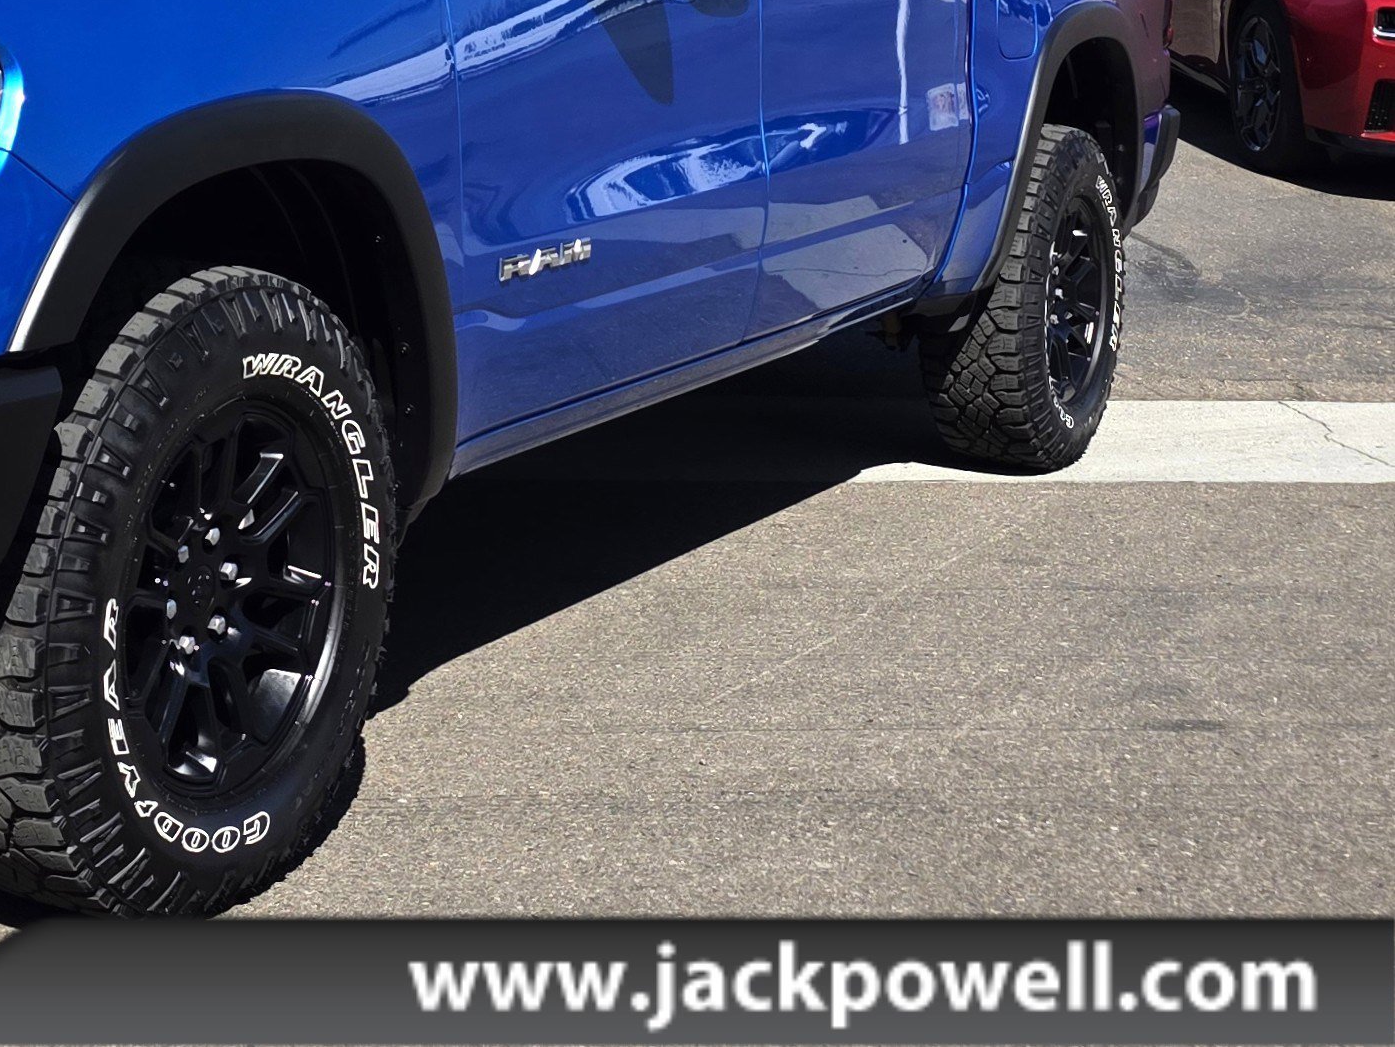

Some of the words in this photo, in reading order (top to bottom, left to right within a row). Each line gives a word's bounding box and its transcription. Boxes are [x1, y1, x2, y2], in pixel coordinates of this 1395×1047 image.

[499, 237, 592, 282] RAM
[242, 352, 381, 590] WRANGLER
[104, 598, 271, 853] GOODYEAR
